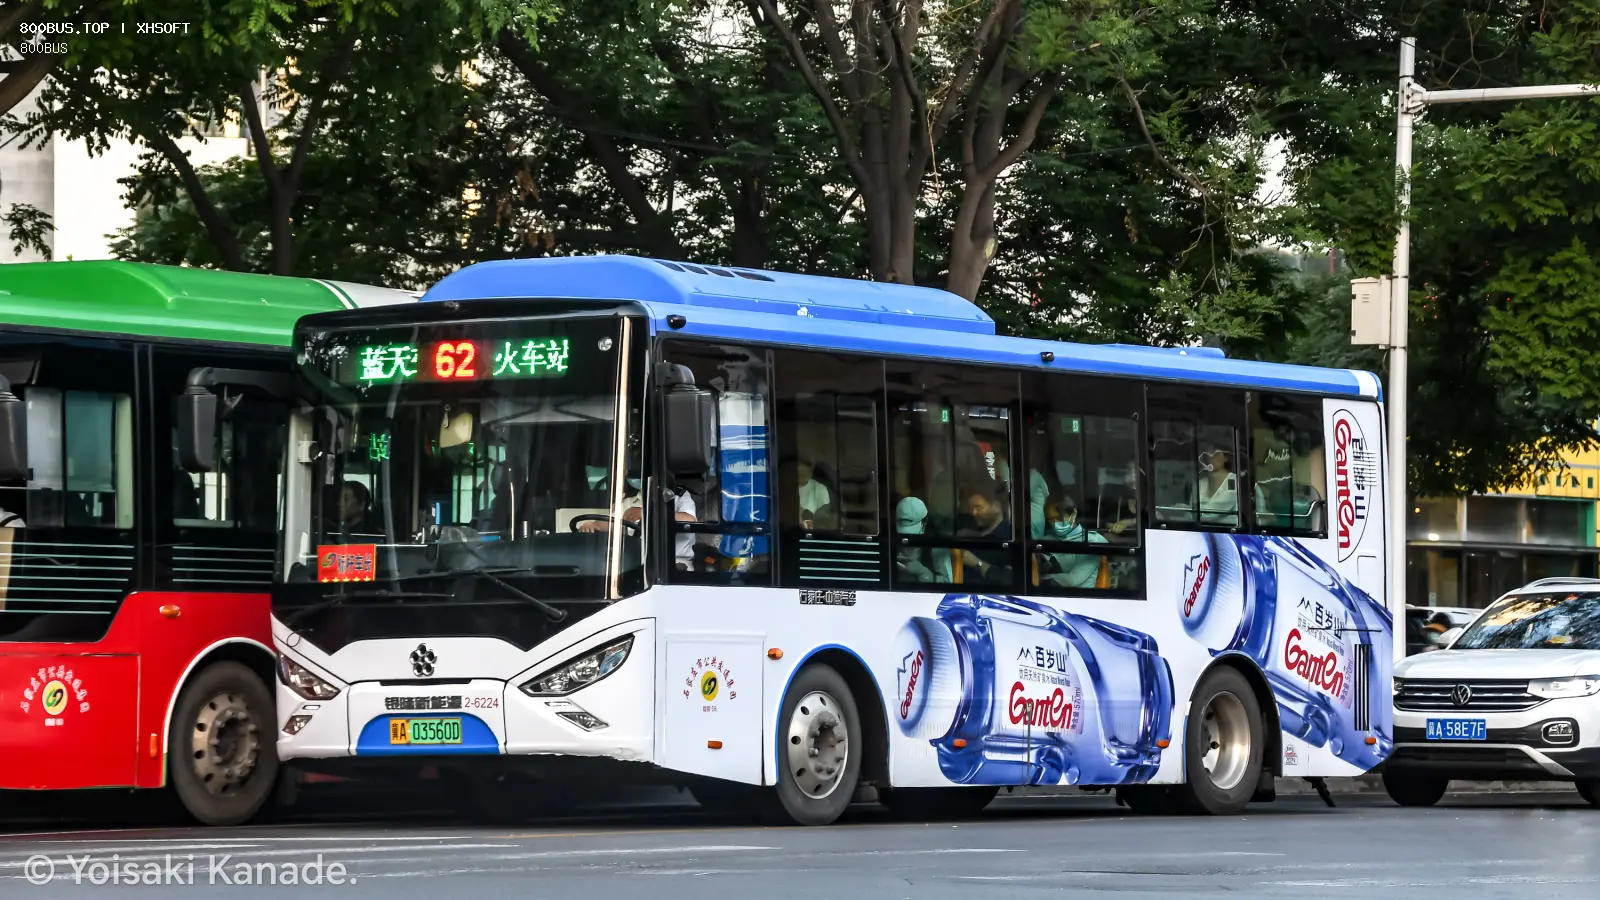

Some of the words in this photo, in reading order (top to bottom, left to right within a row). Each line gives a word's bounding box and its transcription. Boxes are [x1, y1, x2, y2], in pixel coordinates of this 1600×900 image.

[435, 342, 475, 378] 62
[492, 339, 569, 376] 火车站
[1335, 418, 1355, 549] Ganten
[1315, 601, 1343, 640] 百岁山
[1035, 645, 1066, 673] 百岁山
[1284, 627, 1344, 698] Ganten
[464, 697, 500, 709] 2-6224
[1008, 680, 1073, 730] Ganten
